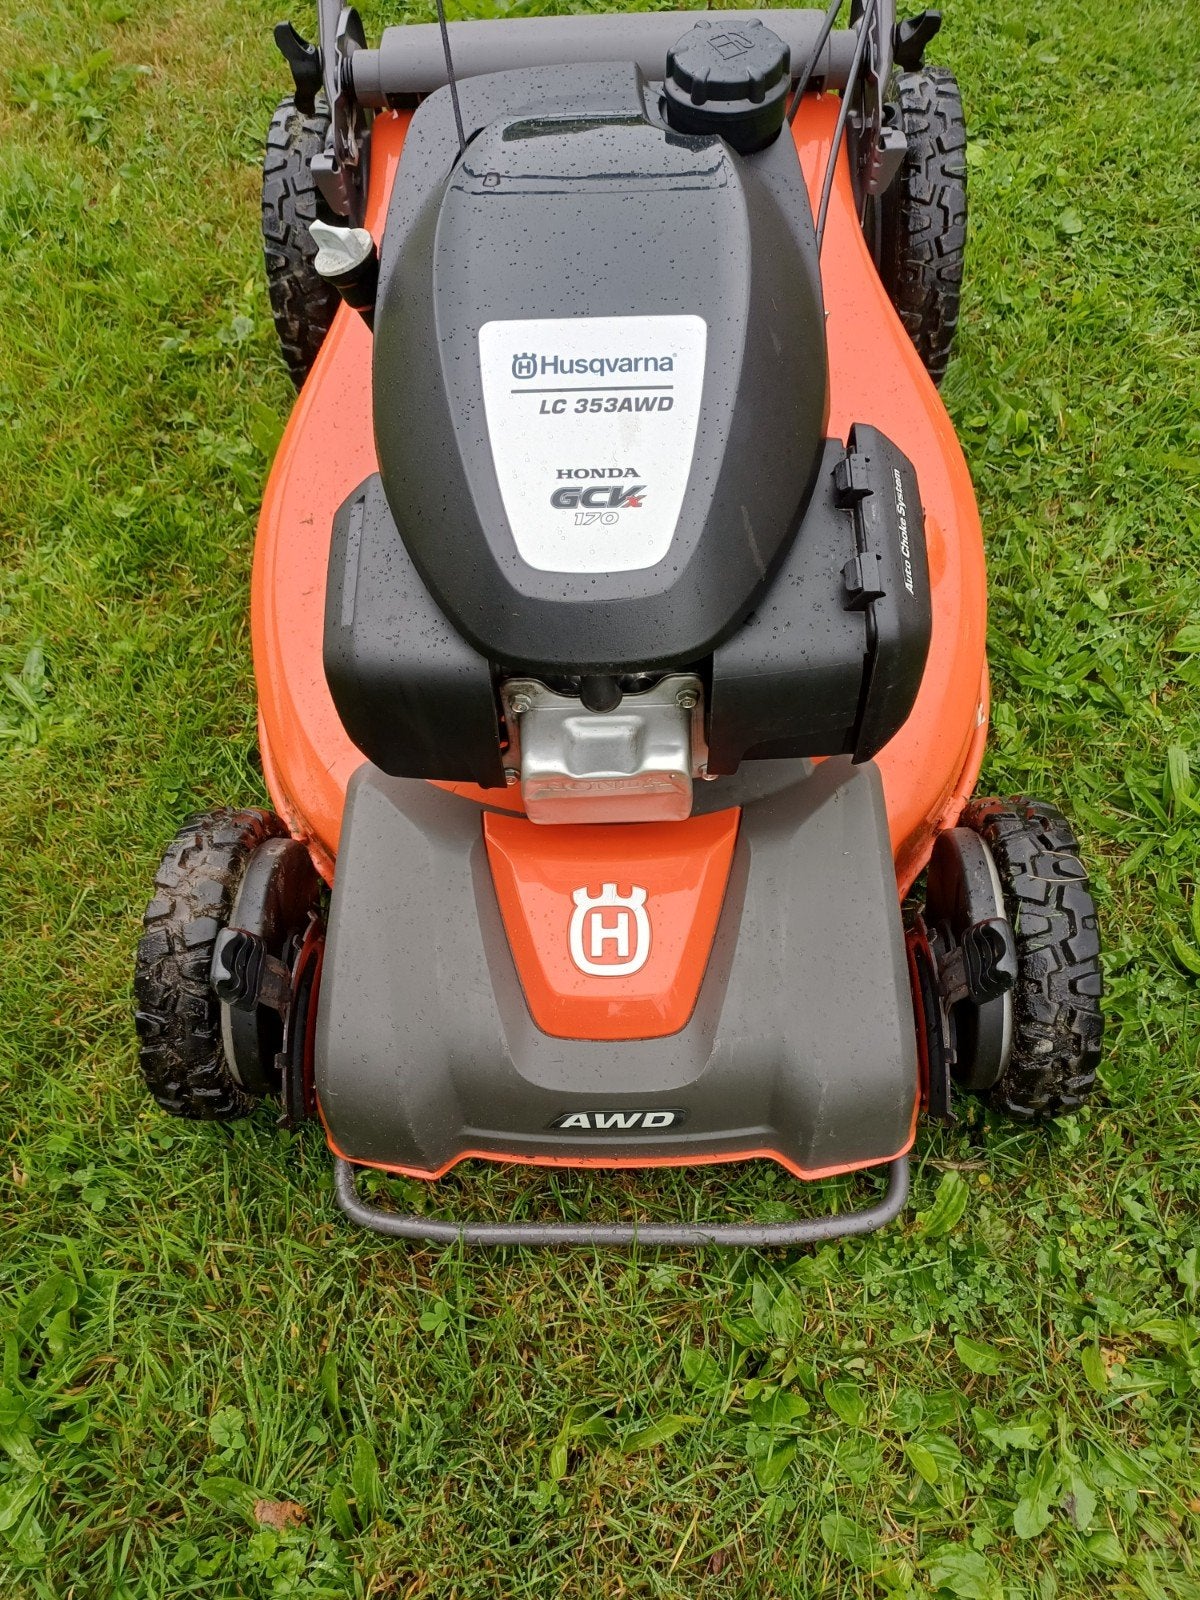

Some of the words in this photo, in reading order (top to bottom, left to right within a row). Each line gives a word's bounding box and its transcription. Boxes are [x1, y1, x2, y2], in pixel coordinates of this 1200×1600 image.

[540, 355, 674, 376] Husqvarna
[539, 399, 567, 415] LC
[574, 396, 674, 414] 353AWD
[556, 468, 641, 479] HONDA
[894, 468, 907, 517] System
[574, 512, 619, 526] 170
[898, 517, 910, 559] Choke
[905, 559, 914, 596] Auto
[559, 1111, 675, 1129] AWD
